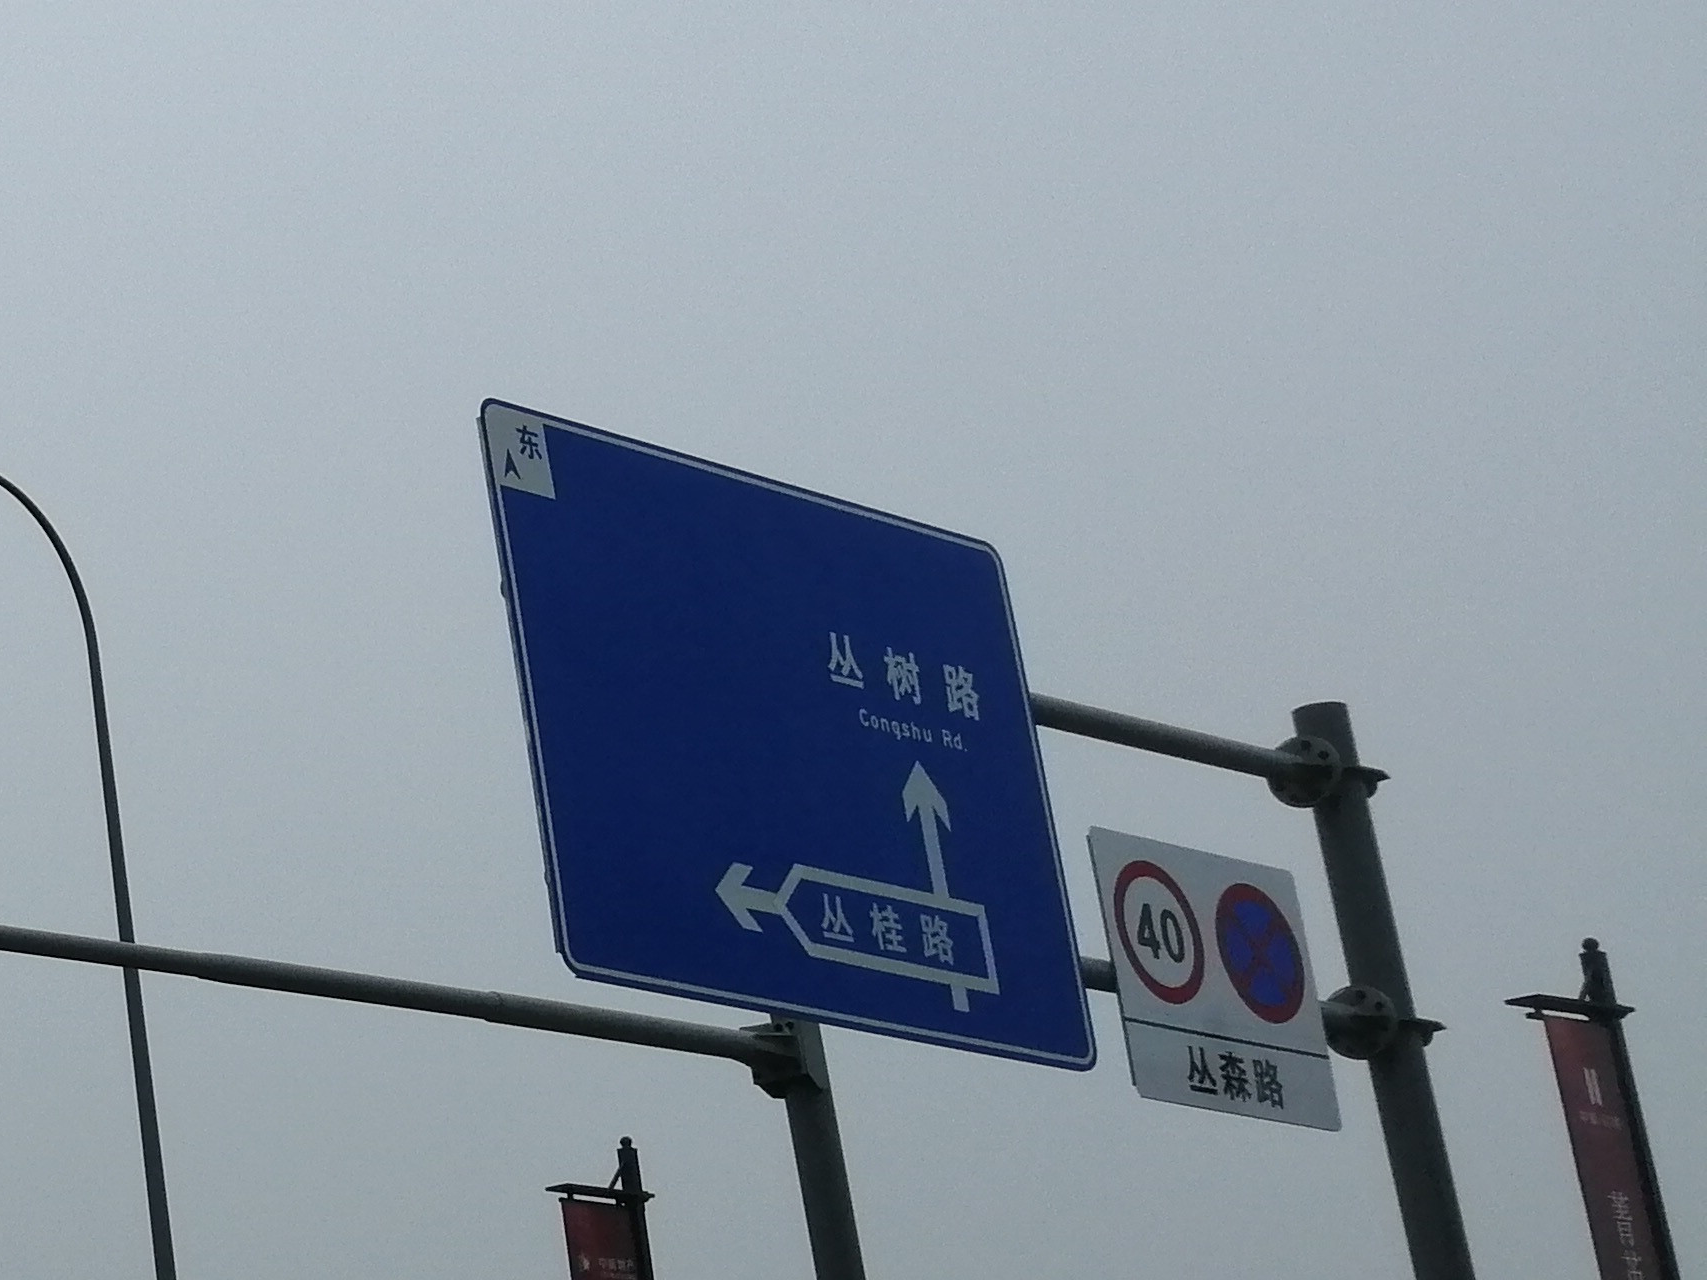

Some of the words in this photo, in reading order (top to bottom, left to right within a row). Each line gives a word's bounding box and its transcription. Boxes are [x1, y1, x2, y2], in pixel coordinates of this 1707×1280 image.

[514, 424, 543, 460] 东
[827, 631, 980, 721] 丛树路
[858, 708, 933, 743] Congshu
[941, 728, 968, 753] Rd.
[820, 892, 954, 966] 丛桂路
[1137, 903, 1185, 963] 40
[1187, 1045, 1284, 1109] 丛森路
